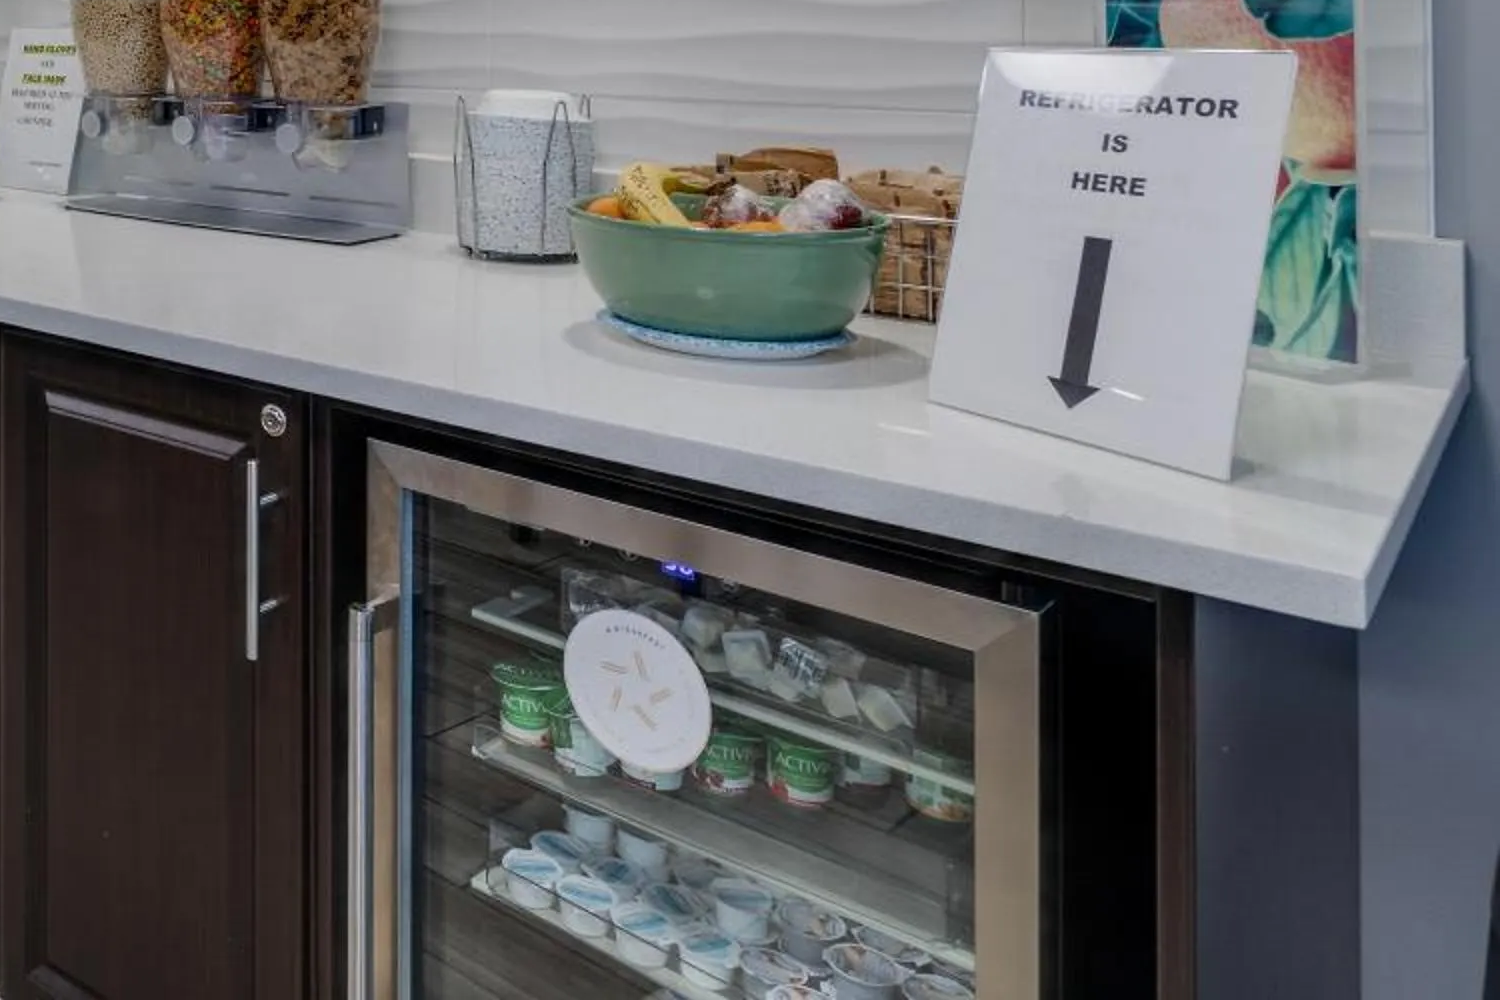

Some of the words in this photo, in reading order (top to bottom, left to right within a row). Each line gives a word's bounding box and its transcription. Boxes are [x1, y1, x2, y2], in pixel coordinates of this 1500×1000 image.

[1019, 89, 1240, 119] REFRIGERATOR
[1100, 133, 1129, 153] IS
[1070, 171, 1148, 197] HERE
[501, 692, 544, 714] ACTIV
[774, 751, 827, 774] ACTIV
